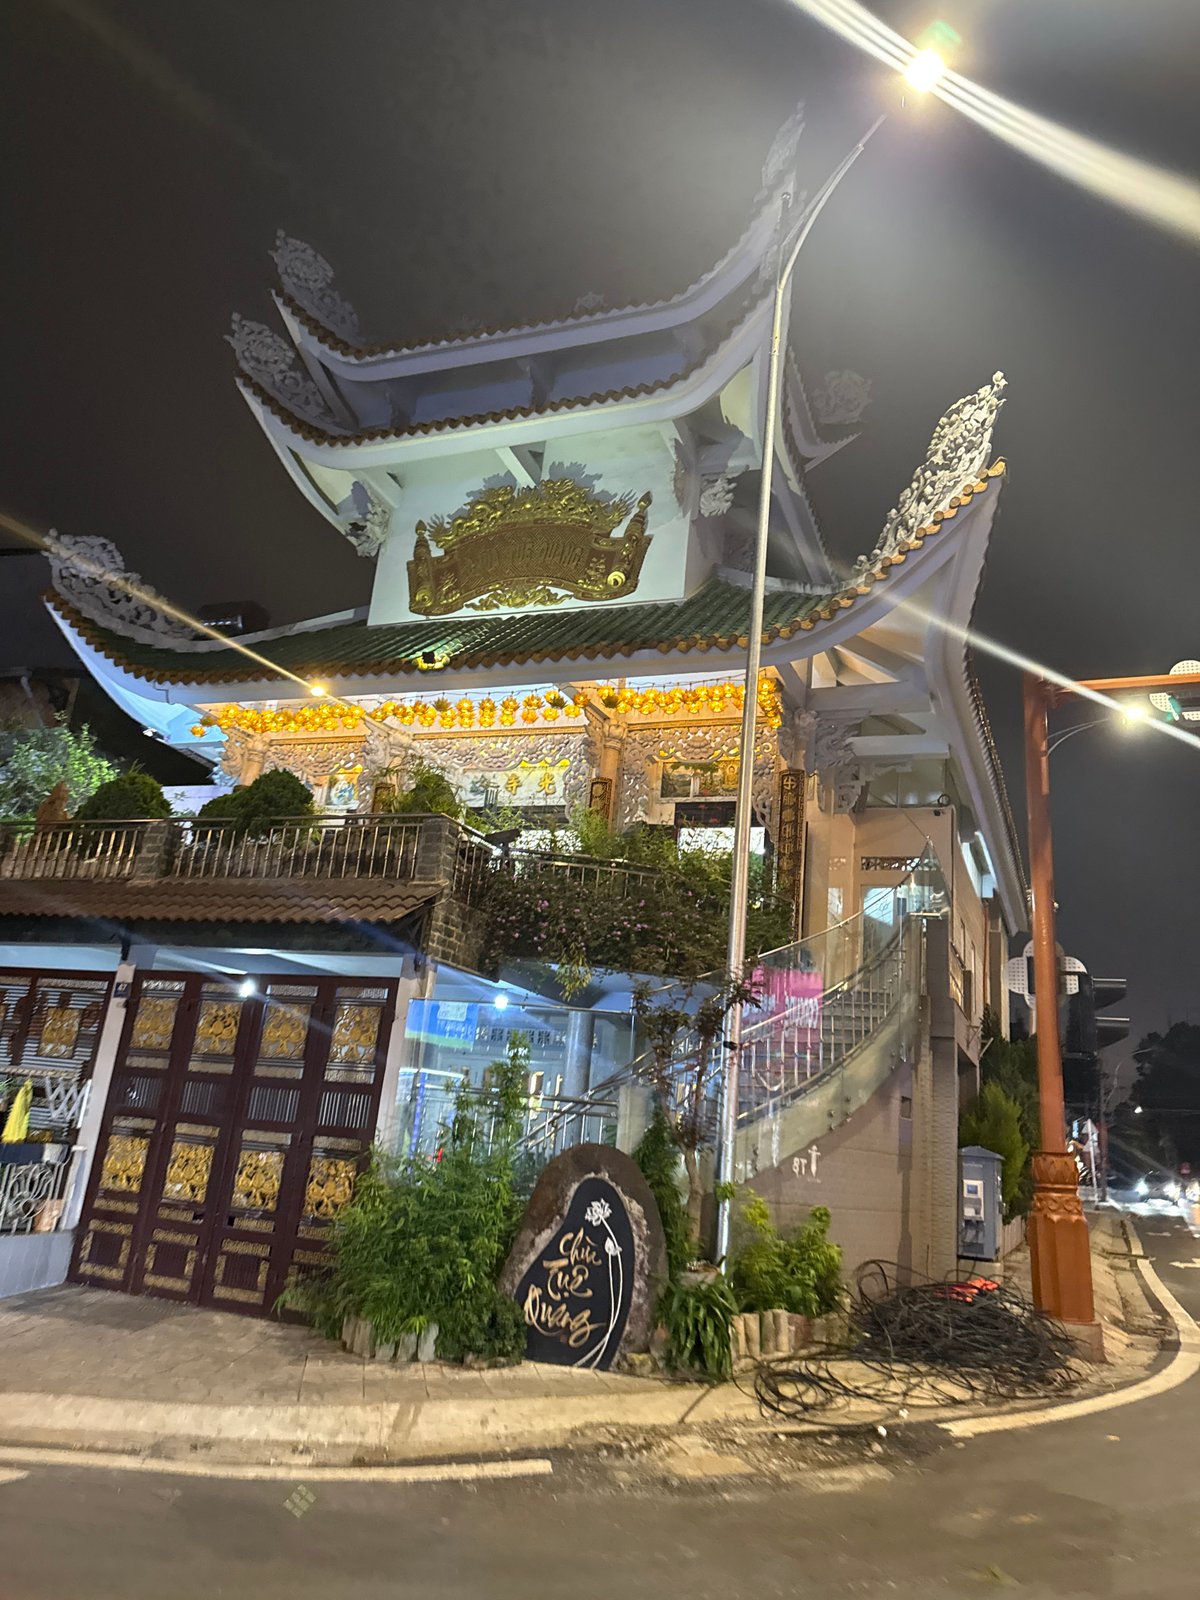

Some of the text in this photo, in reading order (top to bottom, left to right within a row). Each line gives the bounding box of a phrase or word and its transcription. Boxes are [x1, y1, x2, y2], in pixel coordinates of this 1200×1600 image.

[559, 1227, 602, 1266] Chùa
[543, 1258, 593, 1301] Tuệ
[523, 1284, 606, 1349] Quang
